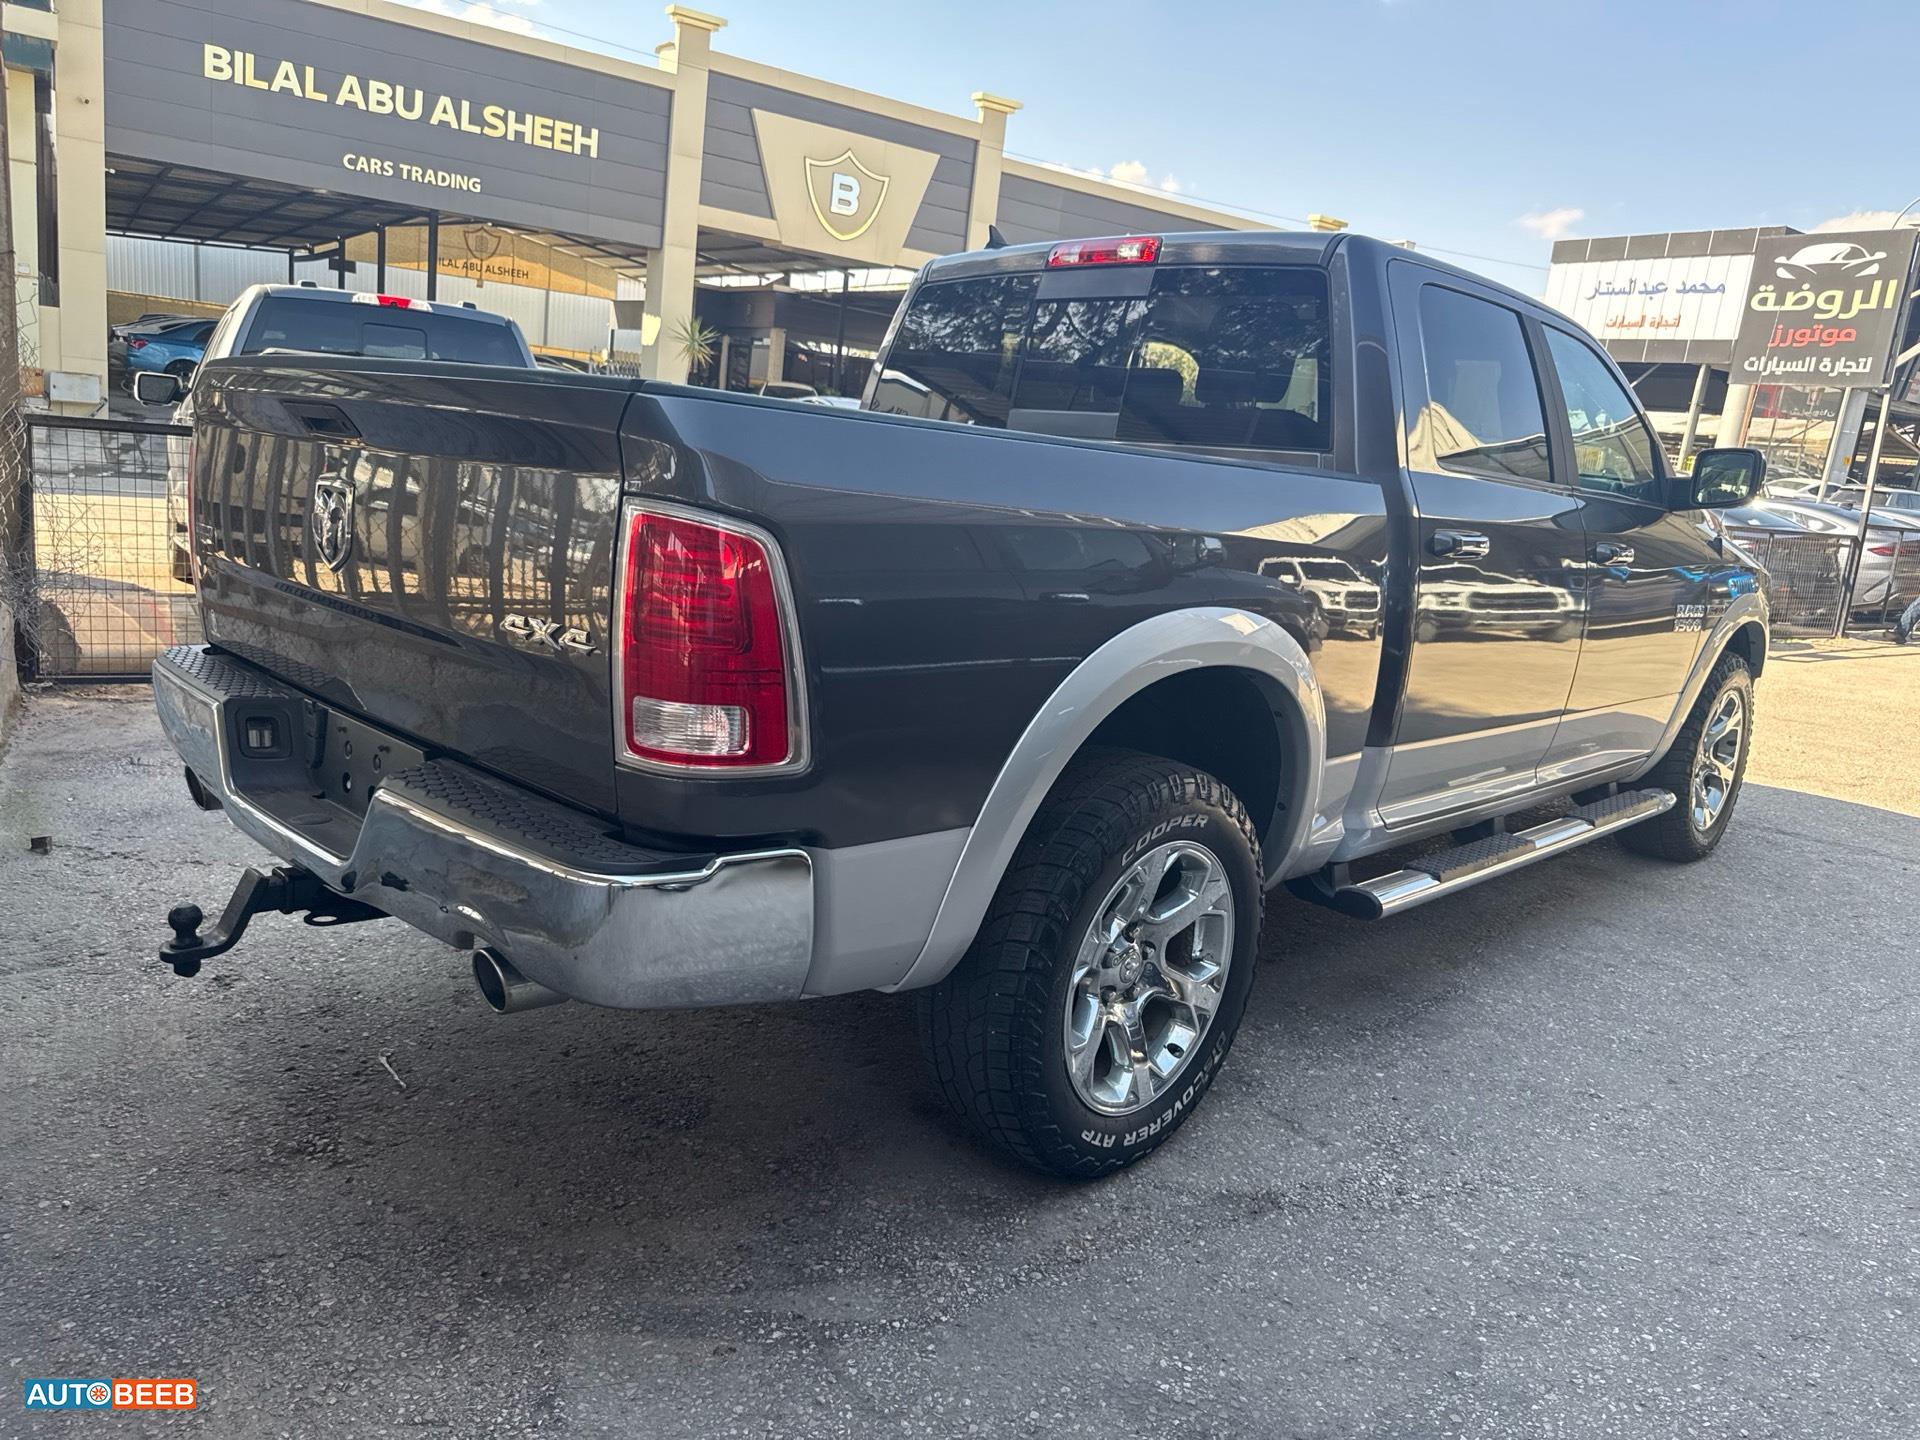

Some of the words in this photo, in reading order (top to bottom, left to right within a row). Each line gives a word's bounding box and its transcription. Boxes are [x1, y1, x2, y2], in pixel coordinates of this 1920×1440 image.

[203, 43, 328, 103] BILAL
[335, 74, 424, 121] ABU
[429, 95, 600, 159] ALSHEEH
[342, 153, 395, 177] CARS
[399, 163, 482, 193] TRADING
[830, 172, 861, 217] B
[462, 262, 483, 273] ABU
[485, 265, 529, 280] ALSHEEH
[1675, 279, 1726, 295] محمد
[1750, 279, 1898, 320] الروضة
[1605, 314, 1647, 330] السيارات
[1649, 314, 1682, 330] لتجارة
[1767, 323, 1857, 348] موتورز
[1743, 356, 1817, 377] السيارات
[1818, 356, 1873, 378] لتجارة
[1676, 604, 1706, 618] RAM
[1121, 813, 1209, 866] COOPER
[1081, 1129, 1117, 1148] ATP
